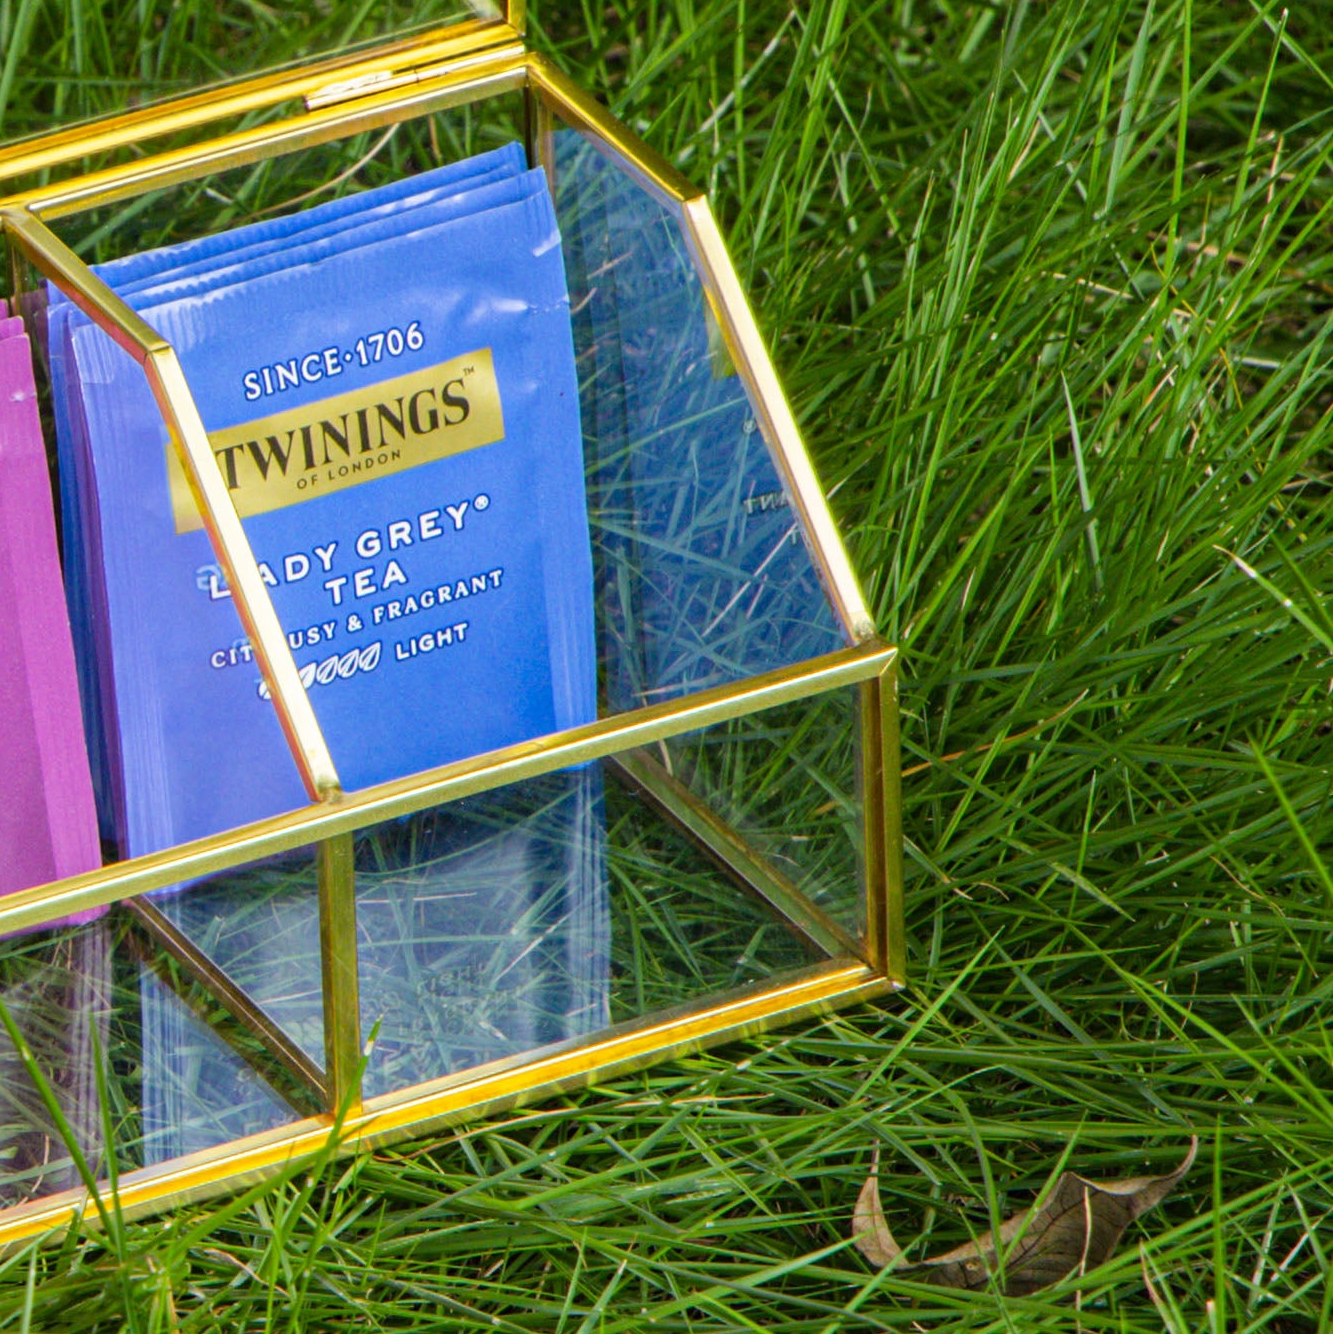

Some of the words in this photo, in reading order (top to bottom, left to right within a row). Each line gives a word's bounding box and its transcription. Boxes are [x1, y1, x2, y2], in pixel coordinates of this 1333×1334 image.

[296, 474, 318, 490] OF
[328, 449, 402, 481] LONDON
[324, 560, 408, 606] TEA
[210, 621, 337, 668] CITUSY
[345, 614, 364, 633] &
[372, 568, 504, 624] FRAGRANT
[394, 622, 469, 662] LIGHT
